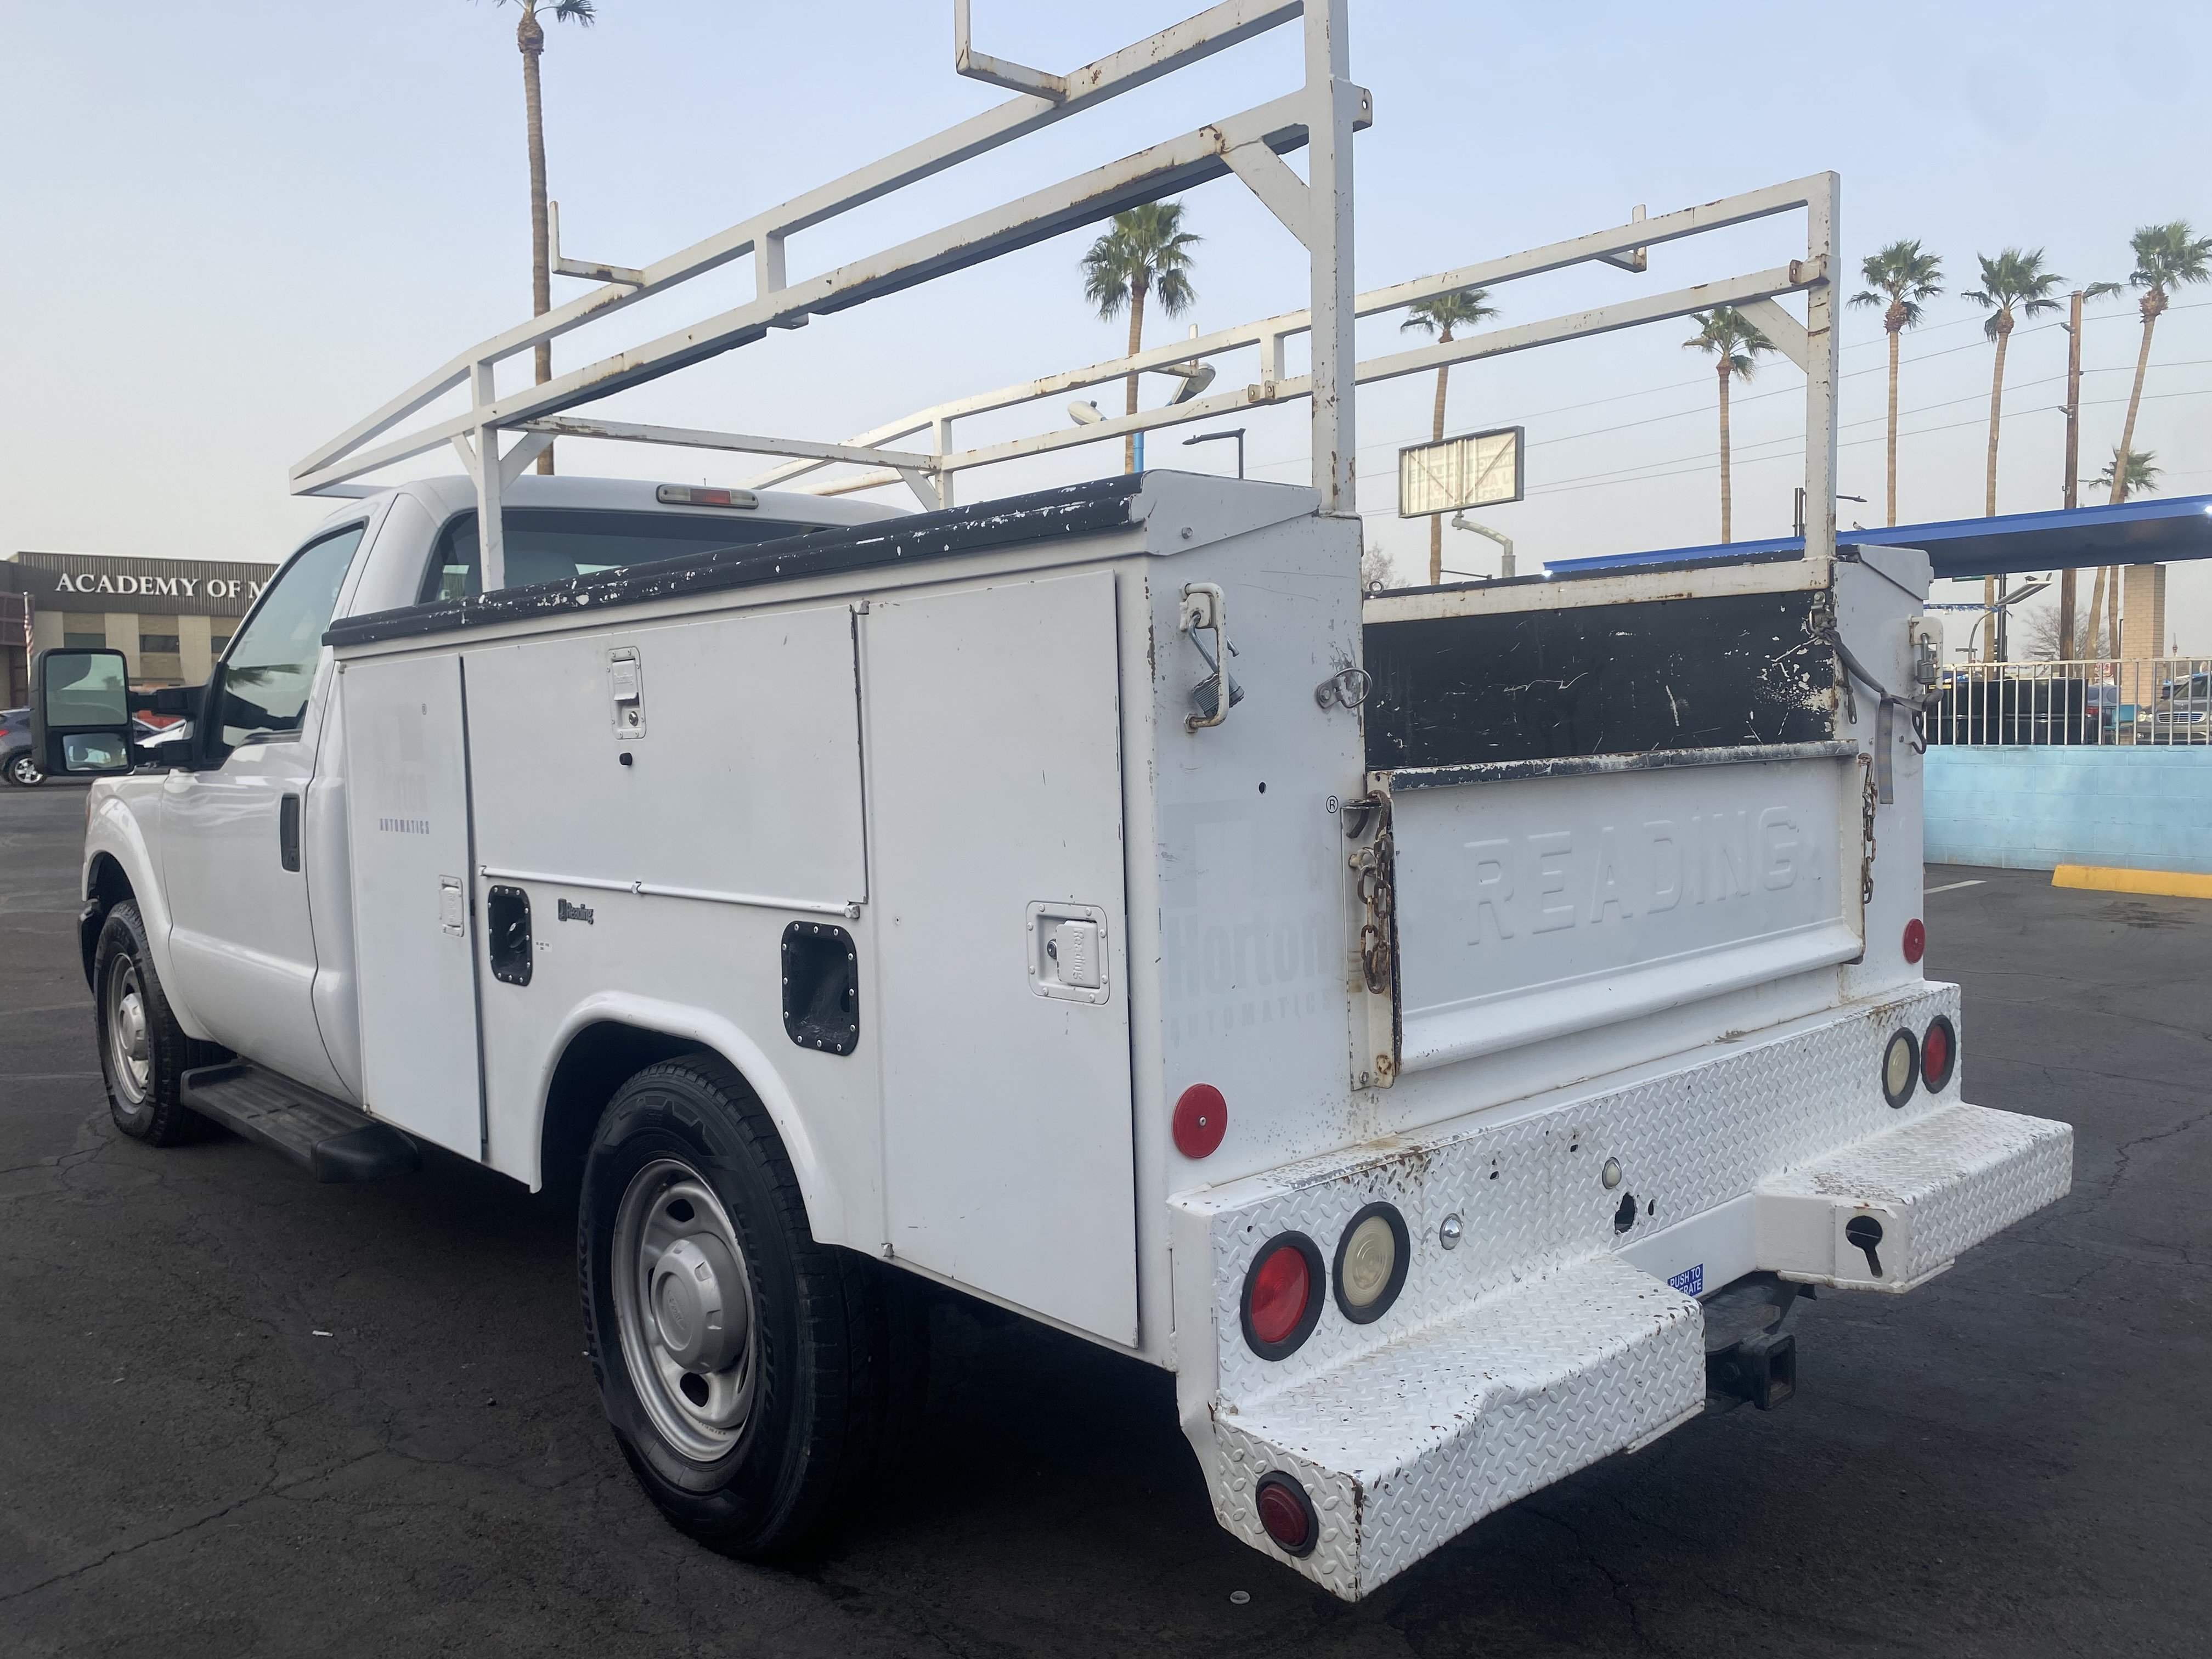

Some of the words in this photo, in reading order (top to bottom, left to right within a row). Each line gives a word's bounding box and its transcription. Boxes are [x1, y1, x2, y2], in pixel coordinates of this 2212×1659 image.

[55, 573, 198, 597] ACADEMY
[207, 579, 240, 599] OF
[380, 819, 430, 834] AUTOMATICS
[1464, 805, 1799, 947] READING
[566, 902, 594, 925] Reading
[1167, 911, 1330, 1002] Horton
[1670, 1271, 1690, 1288] PUSH
[1691, 1266, 1701, 1280] TO
[1679, 1278, 1702, 1295] ERATE
